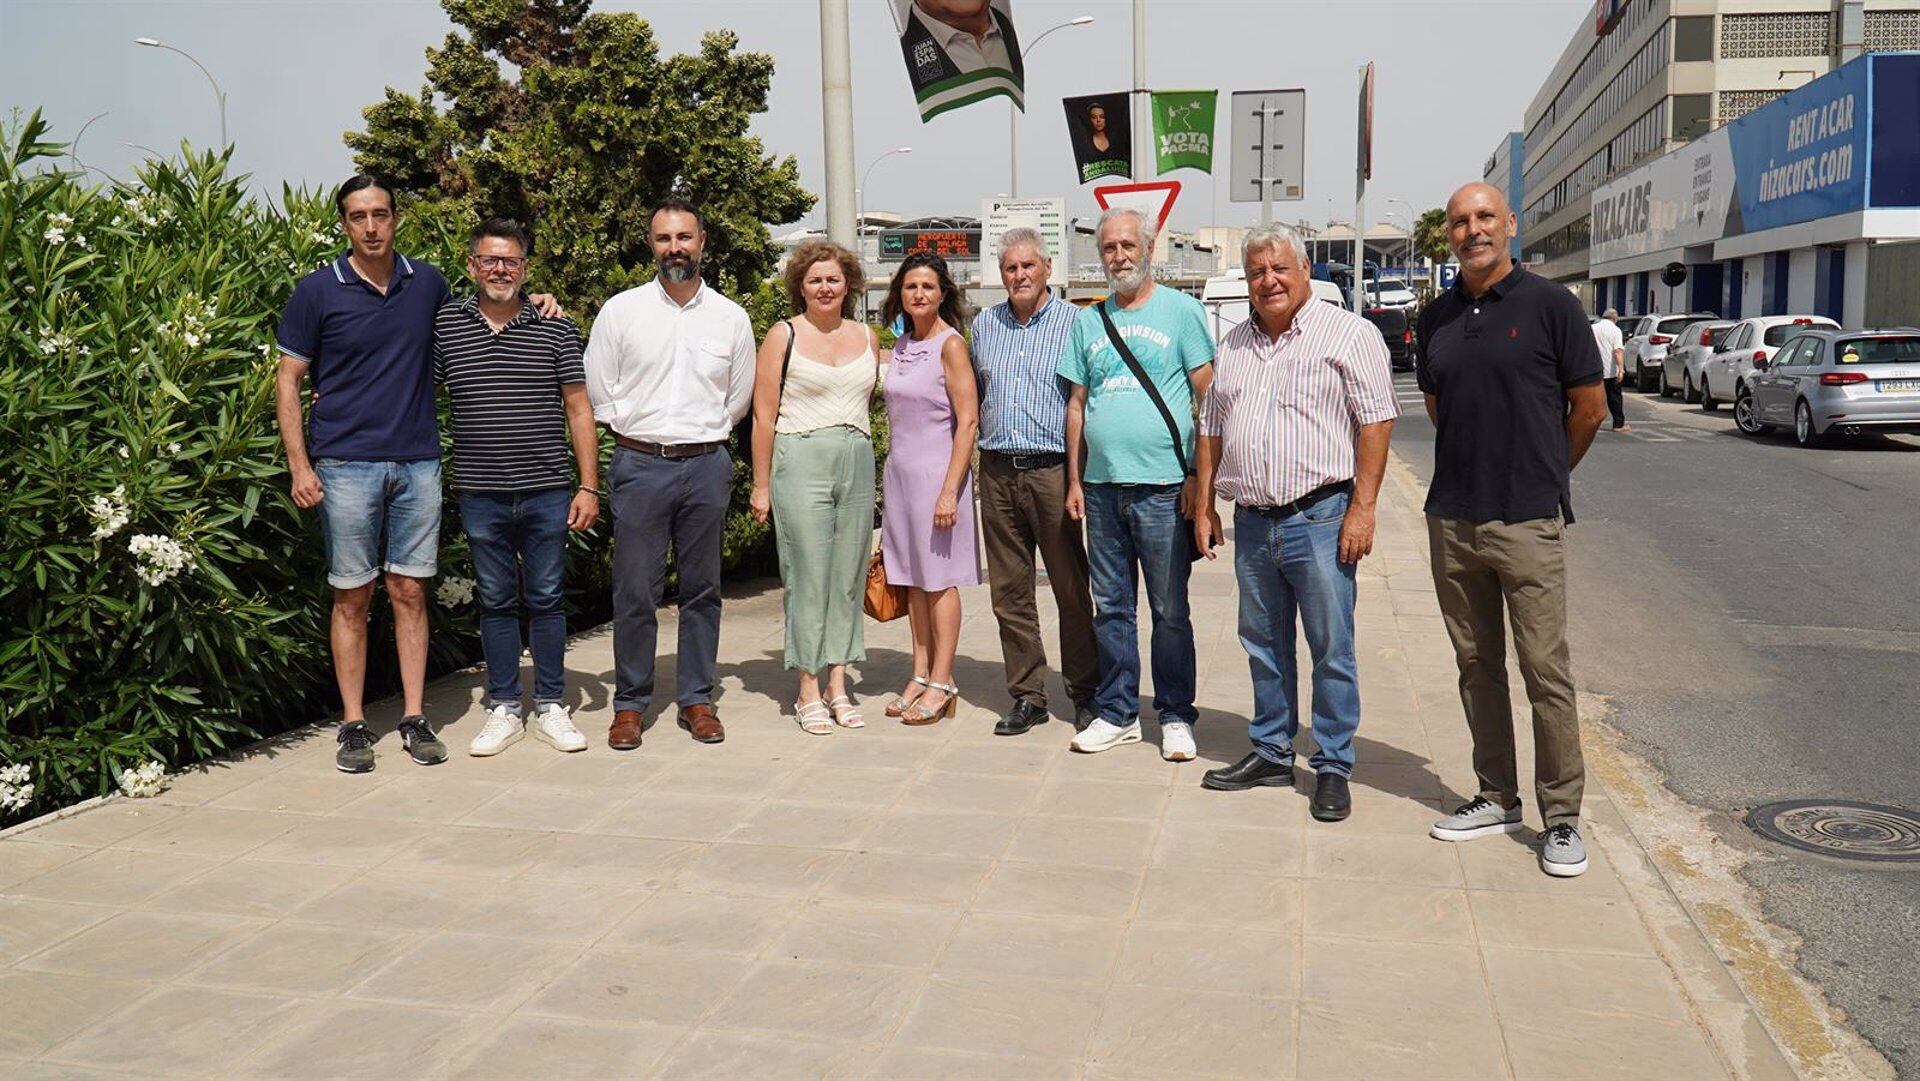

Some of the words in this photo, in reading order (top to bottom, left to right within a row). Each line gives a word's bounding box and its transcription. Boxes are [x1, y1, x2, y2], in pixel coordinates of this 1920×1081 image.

[916, 47, 935, 59] ESPA
[917, 53, 937, 67] DAS
[1787, 108, 1818, 152] RENT
[1817, 105, 1828, 141] A
[1828, 94, 1854, 136] CAR
[1160, 131, 1210, 146] VOTA
[1160, 143, 1209, 157] PACMA
[1759, 144, 1853, 202] nizacars.com
[994, 203, 1001, 212] P
[1592, 180, 1652, 246] NIZACARS
